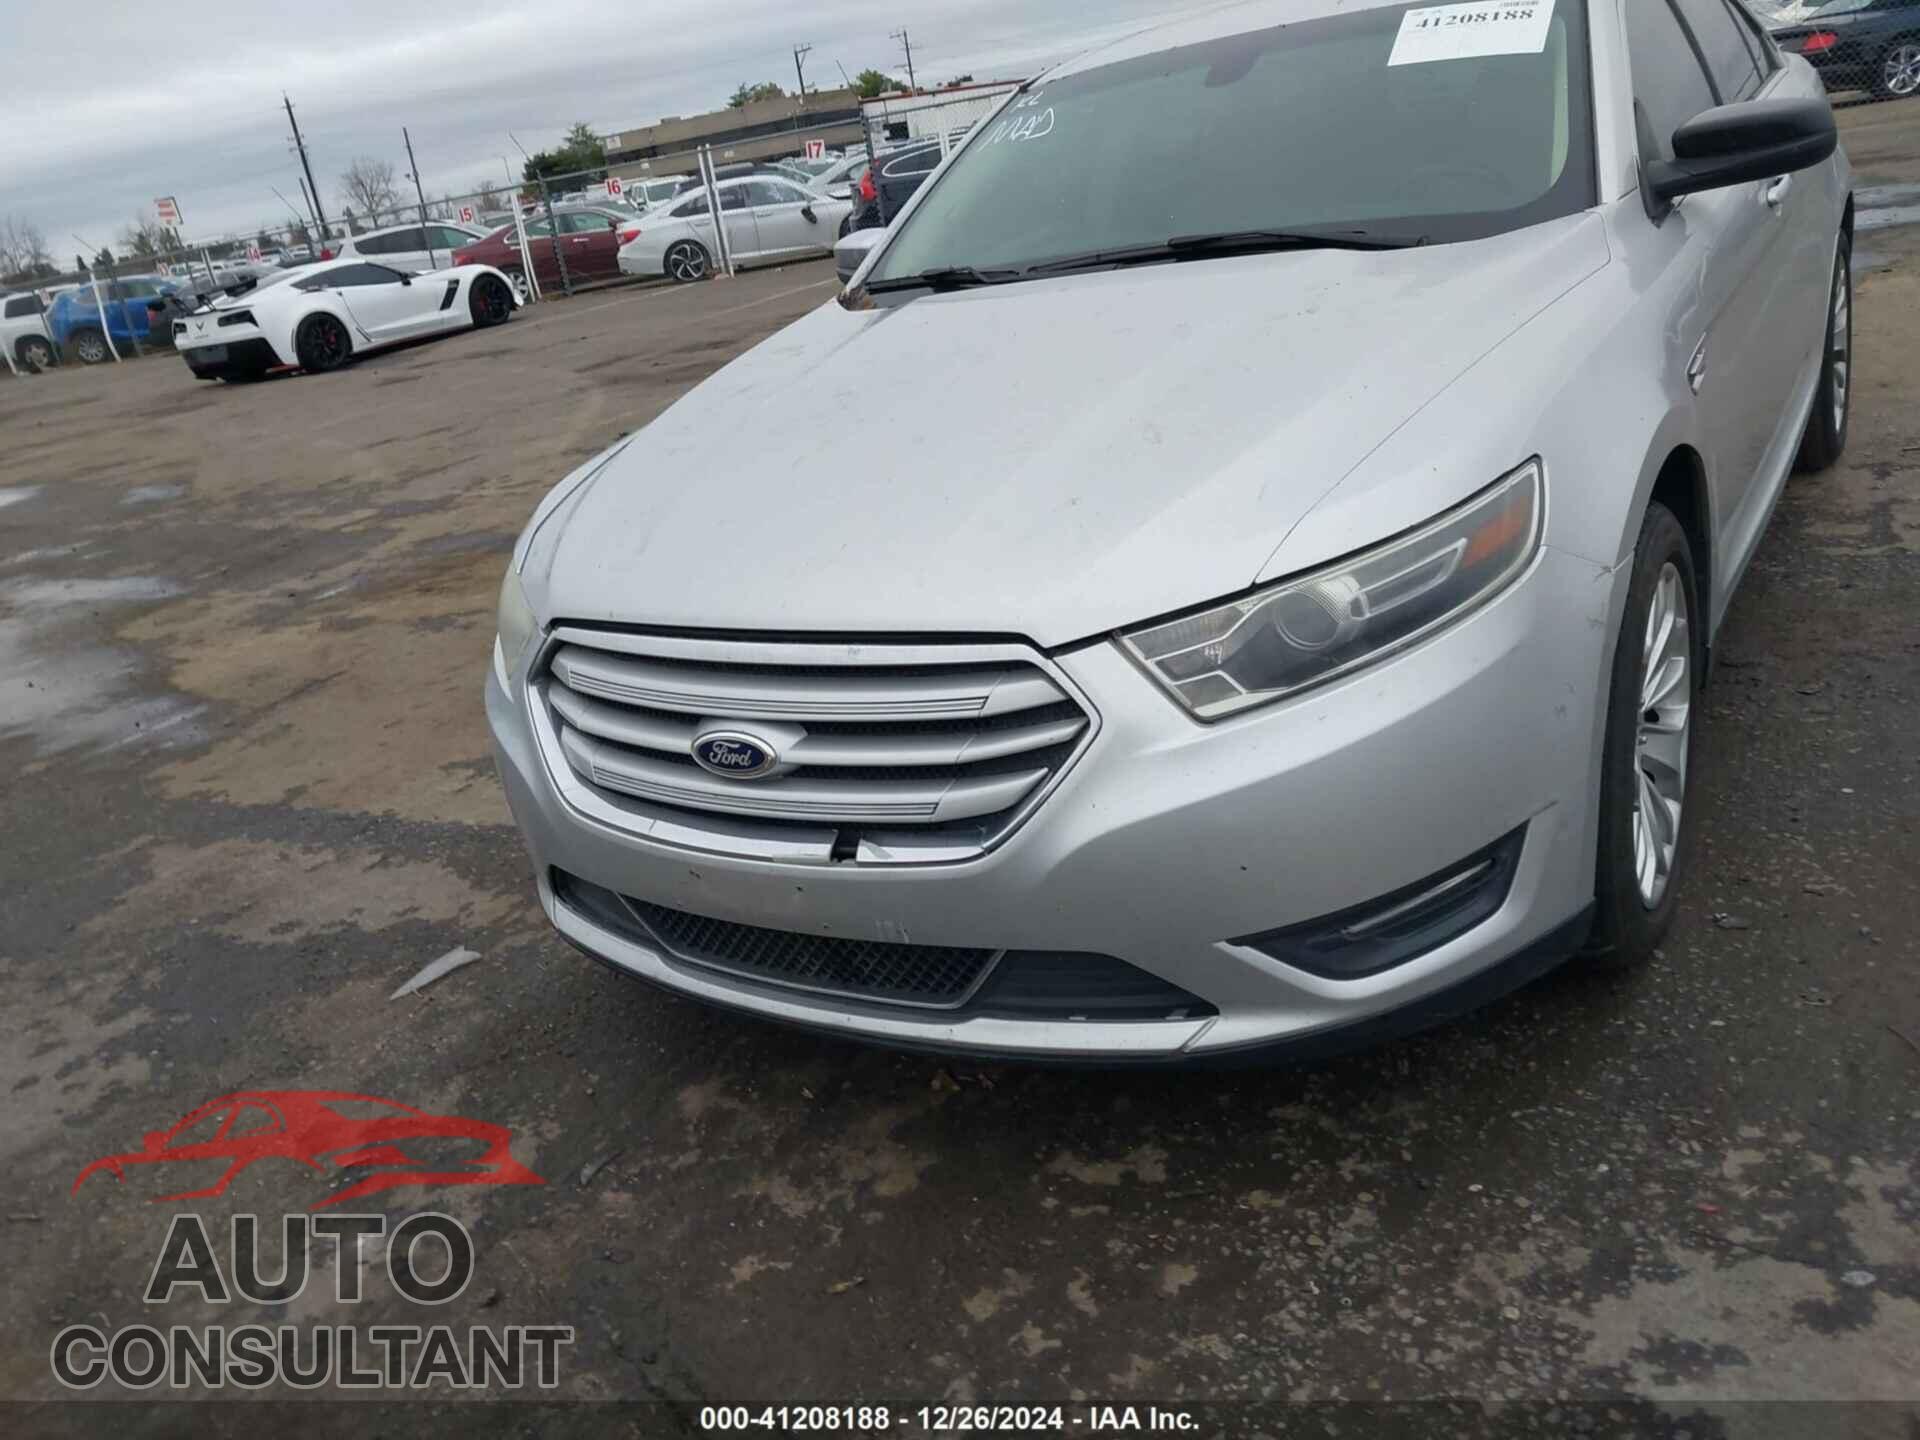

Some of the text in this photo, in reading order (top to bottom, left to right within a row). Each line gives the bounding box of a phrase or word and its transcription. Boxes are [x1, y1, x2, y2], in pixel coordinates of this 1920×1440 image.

[1415, 9, 1533, 28] 41208188
[808, 142, 821, 159] 17
[607, 180, 621, 195] 16
[460, 207, 472, 222] 15
[709, 741, 752, 766] Ford
